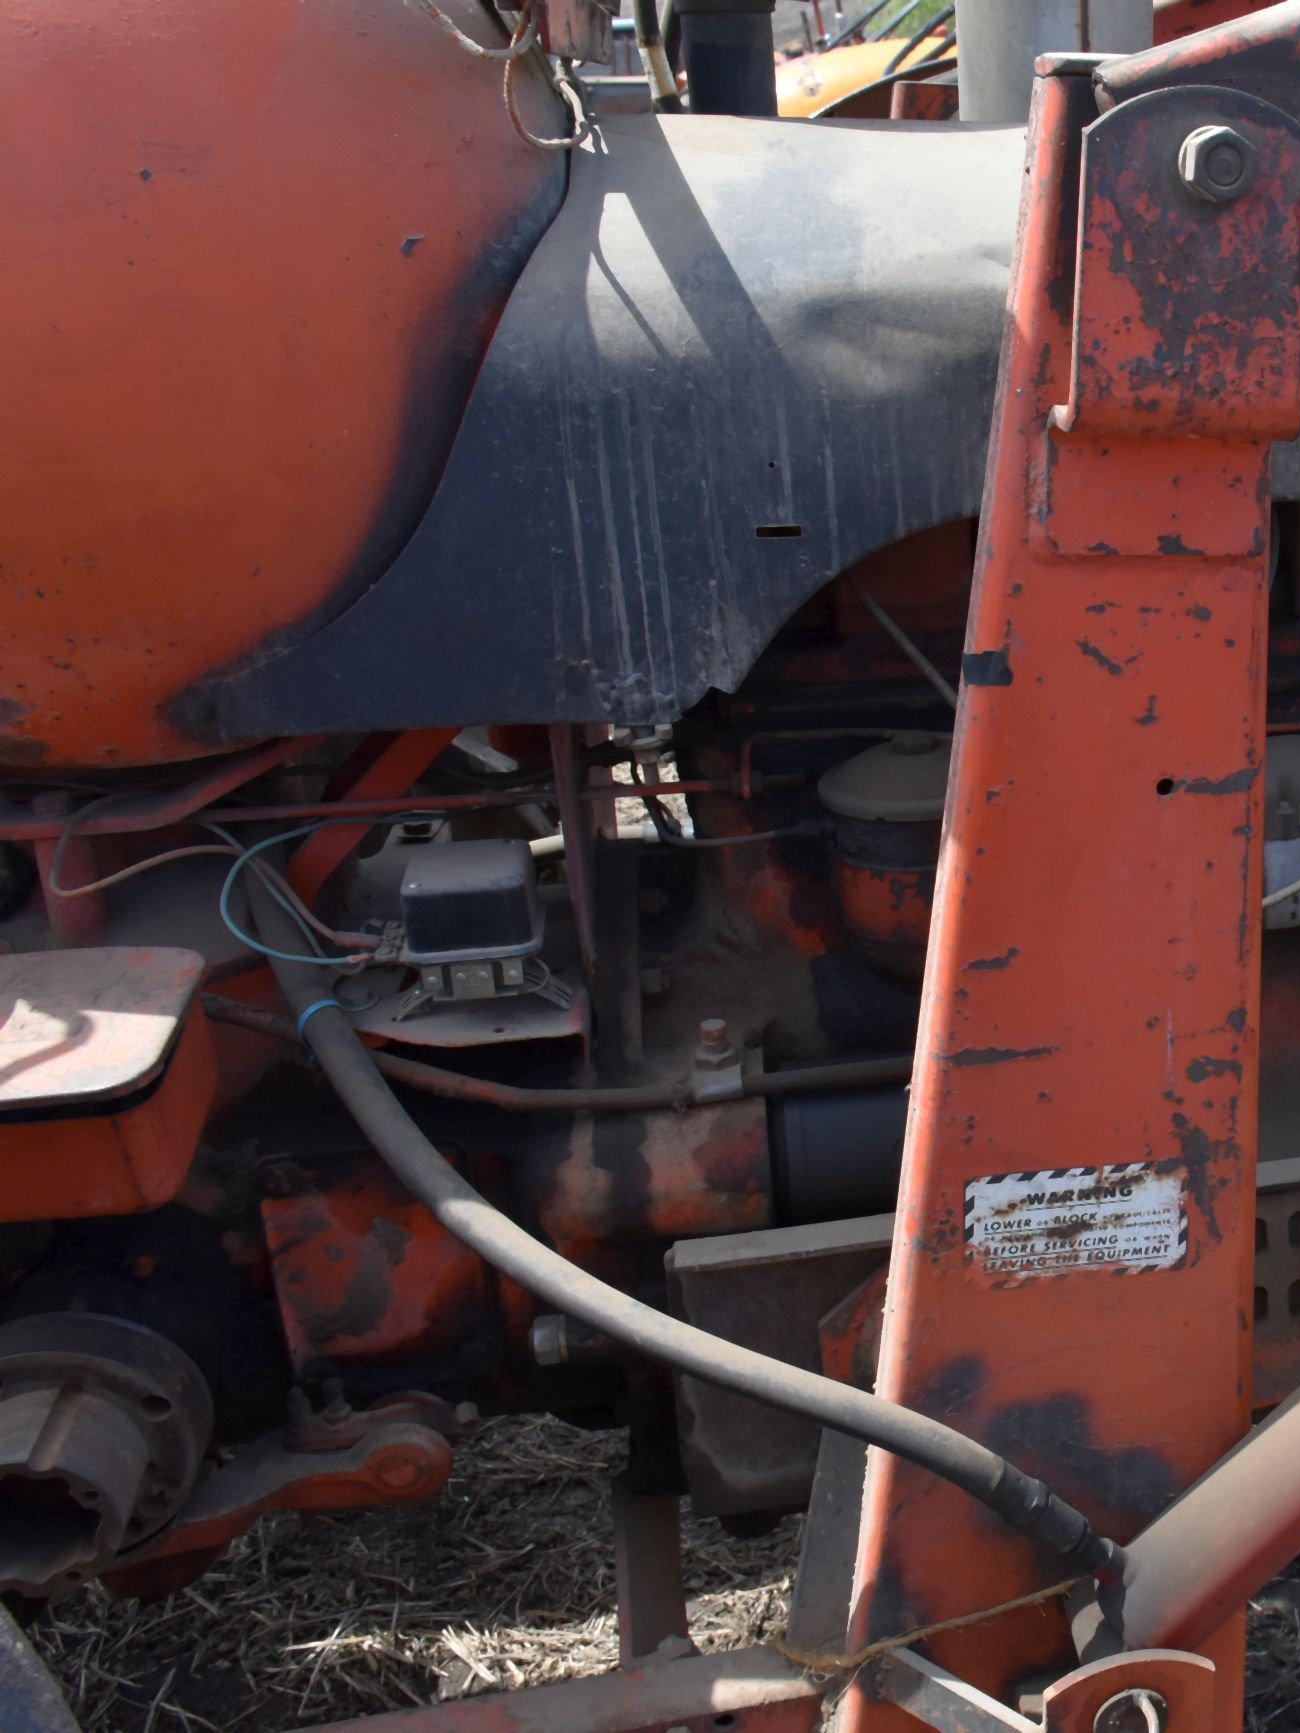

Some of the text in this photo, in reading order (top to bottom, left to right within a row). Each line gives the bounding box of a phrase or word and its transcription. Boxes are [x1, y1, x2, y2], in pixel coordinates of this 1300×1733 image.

[984, 1218, 1032, 1232] LOWER
[1053, 1211, 1098, 1226] BLOCK
[984, 1243, 1035, 1258] BEFORE
[1043, 1235, 1119, 1252] SERVICING
[1087, 1243, 1170, 1262] EQUIPMENT
